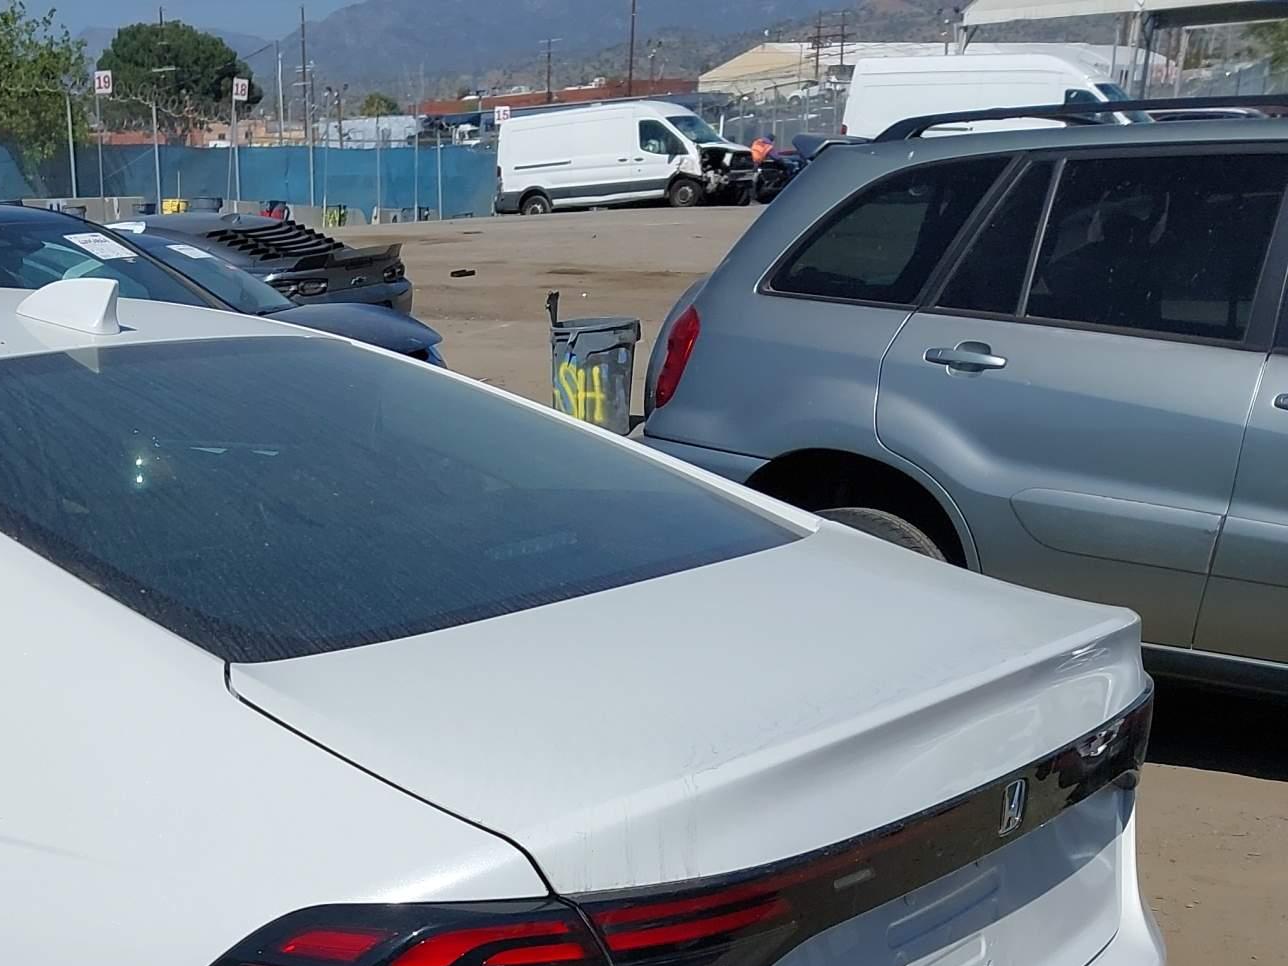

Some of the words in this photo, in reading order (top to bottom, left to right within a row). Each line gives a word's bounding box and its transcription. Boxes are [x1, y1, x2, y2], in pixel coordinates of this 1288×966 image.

[96, 74, 110, 90] 19
[234, 82, 247, 97] 18
[495, 109, 509, 121] 15
